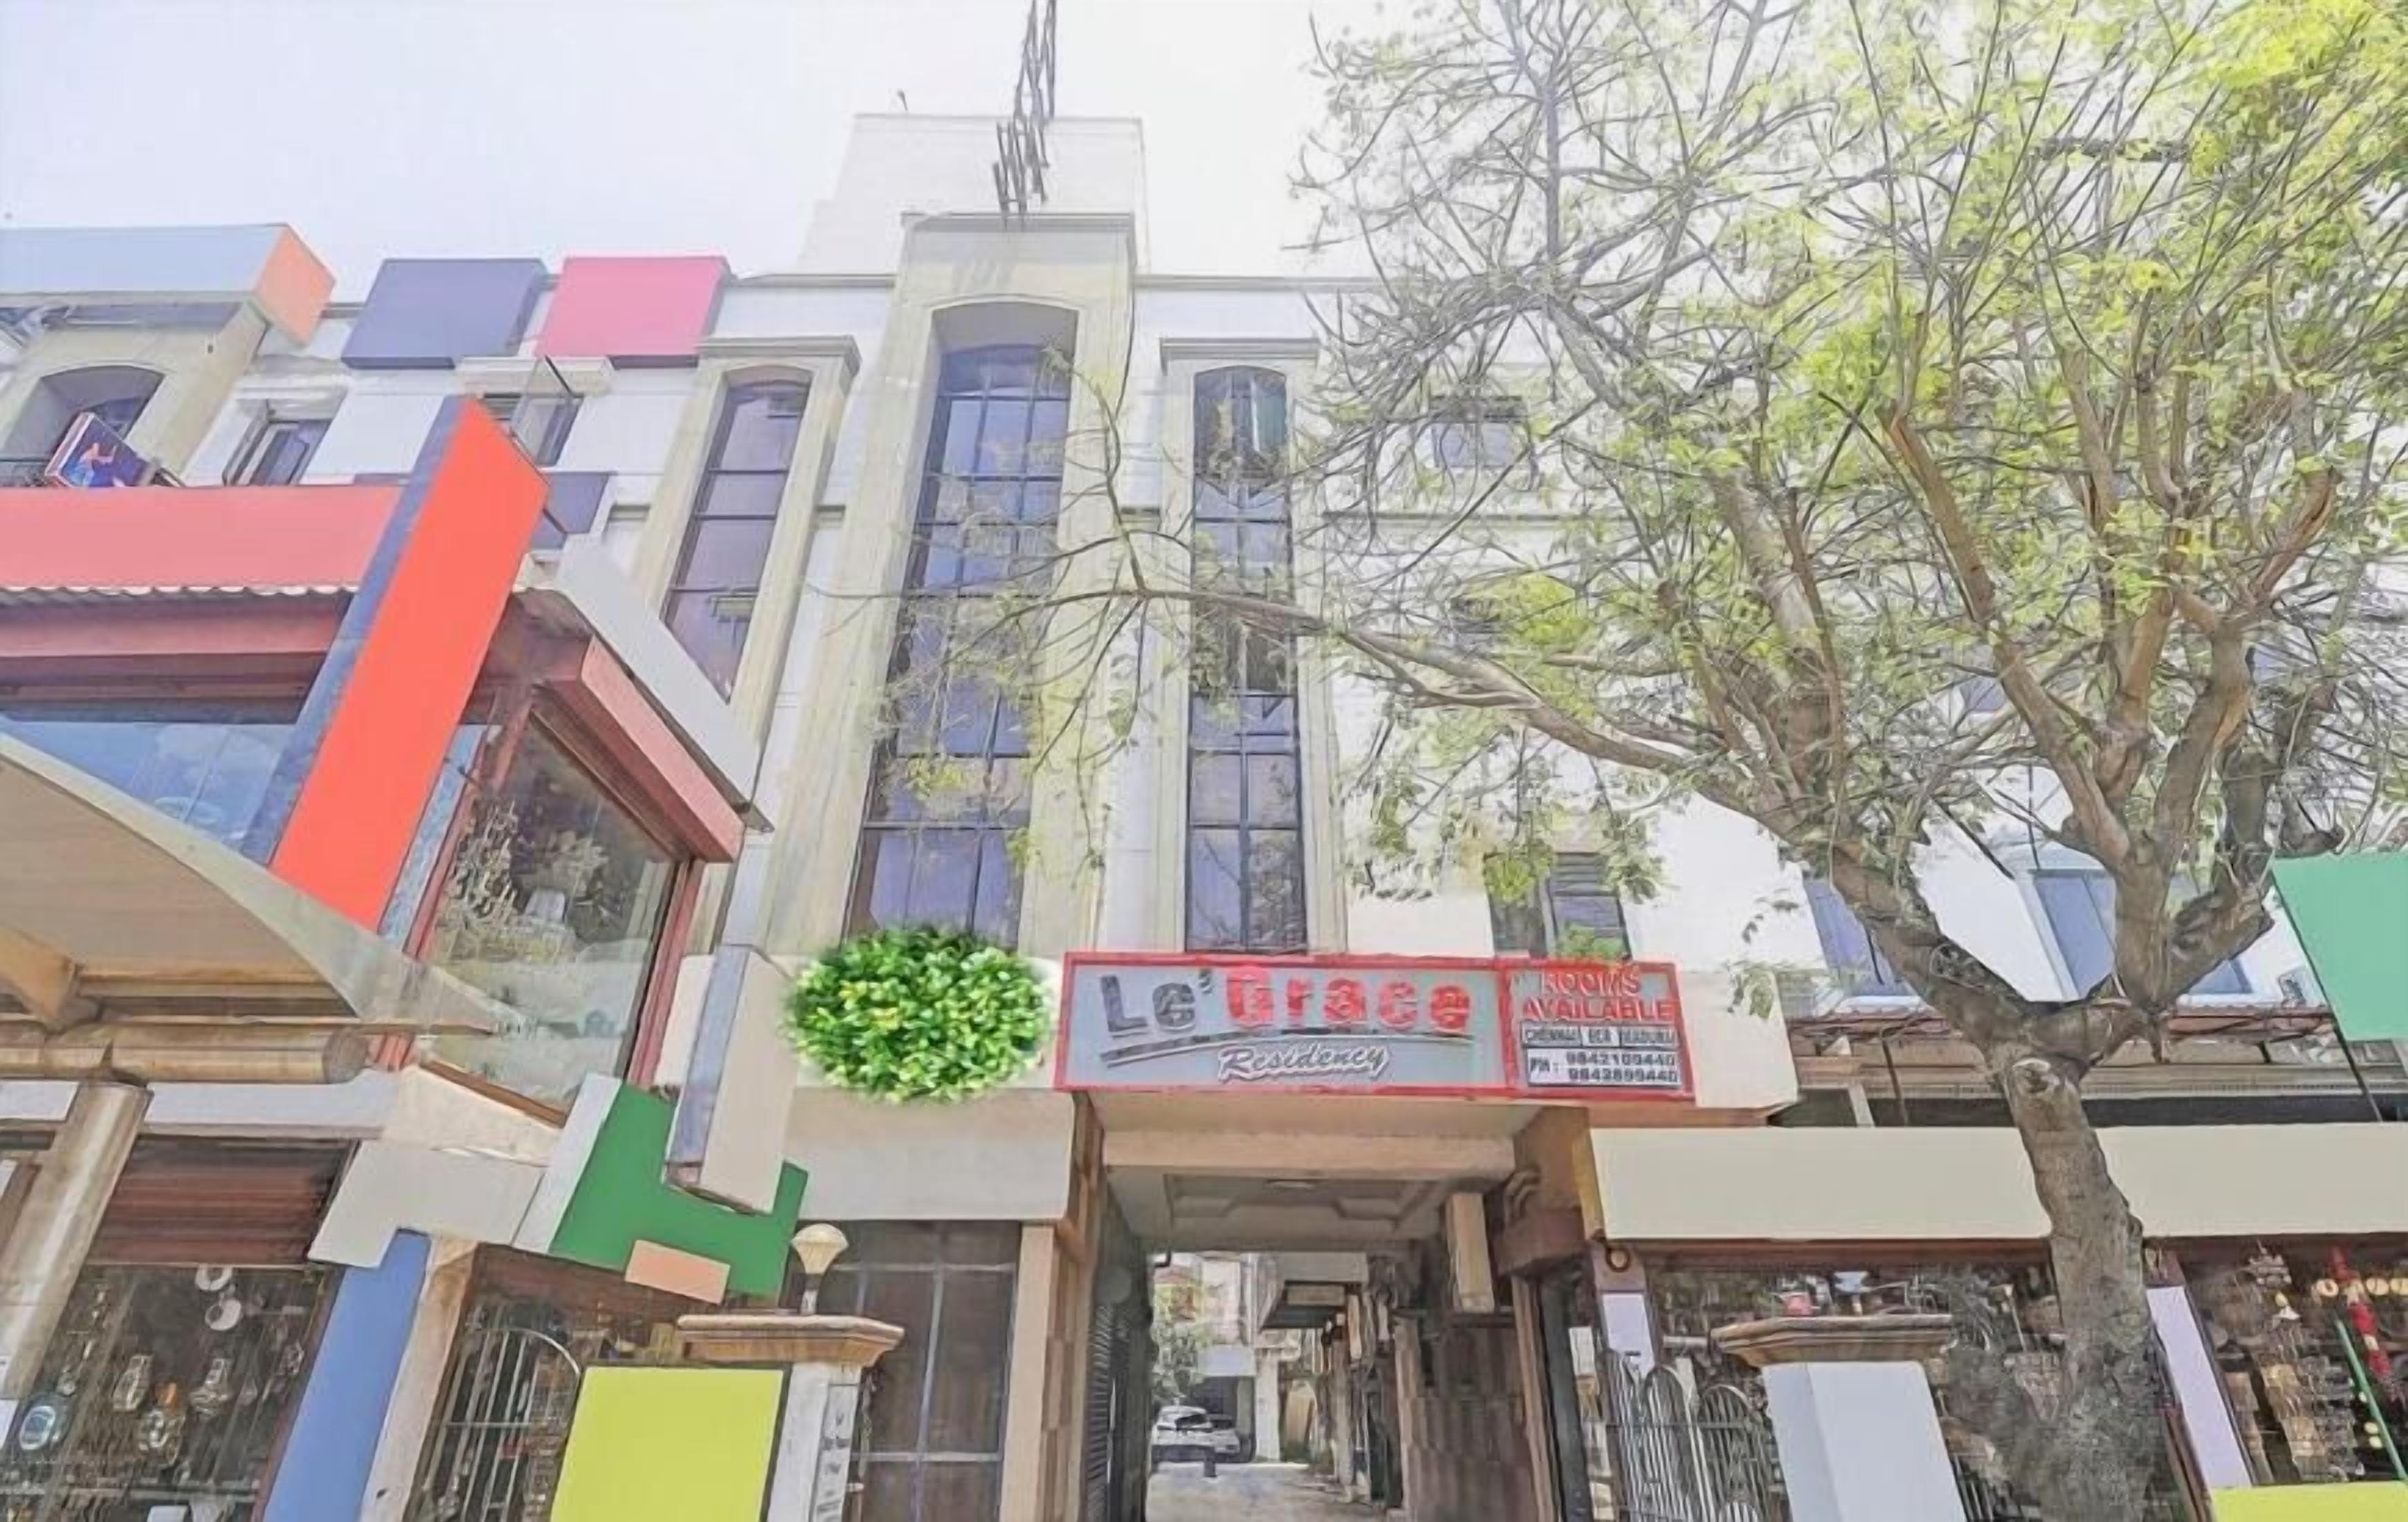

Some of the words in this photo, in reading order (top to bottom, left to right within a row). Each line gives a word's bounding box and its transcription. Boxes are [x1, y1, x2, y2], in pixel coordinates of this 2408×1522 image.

[1542, 966, 1641, 996] ROOMS
[1226, 964, 1472, 1034] Grace
[1523, 994, 1676, 1023] AVAILABLE
[1218, 1043, 1389, 1083] Residency
